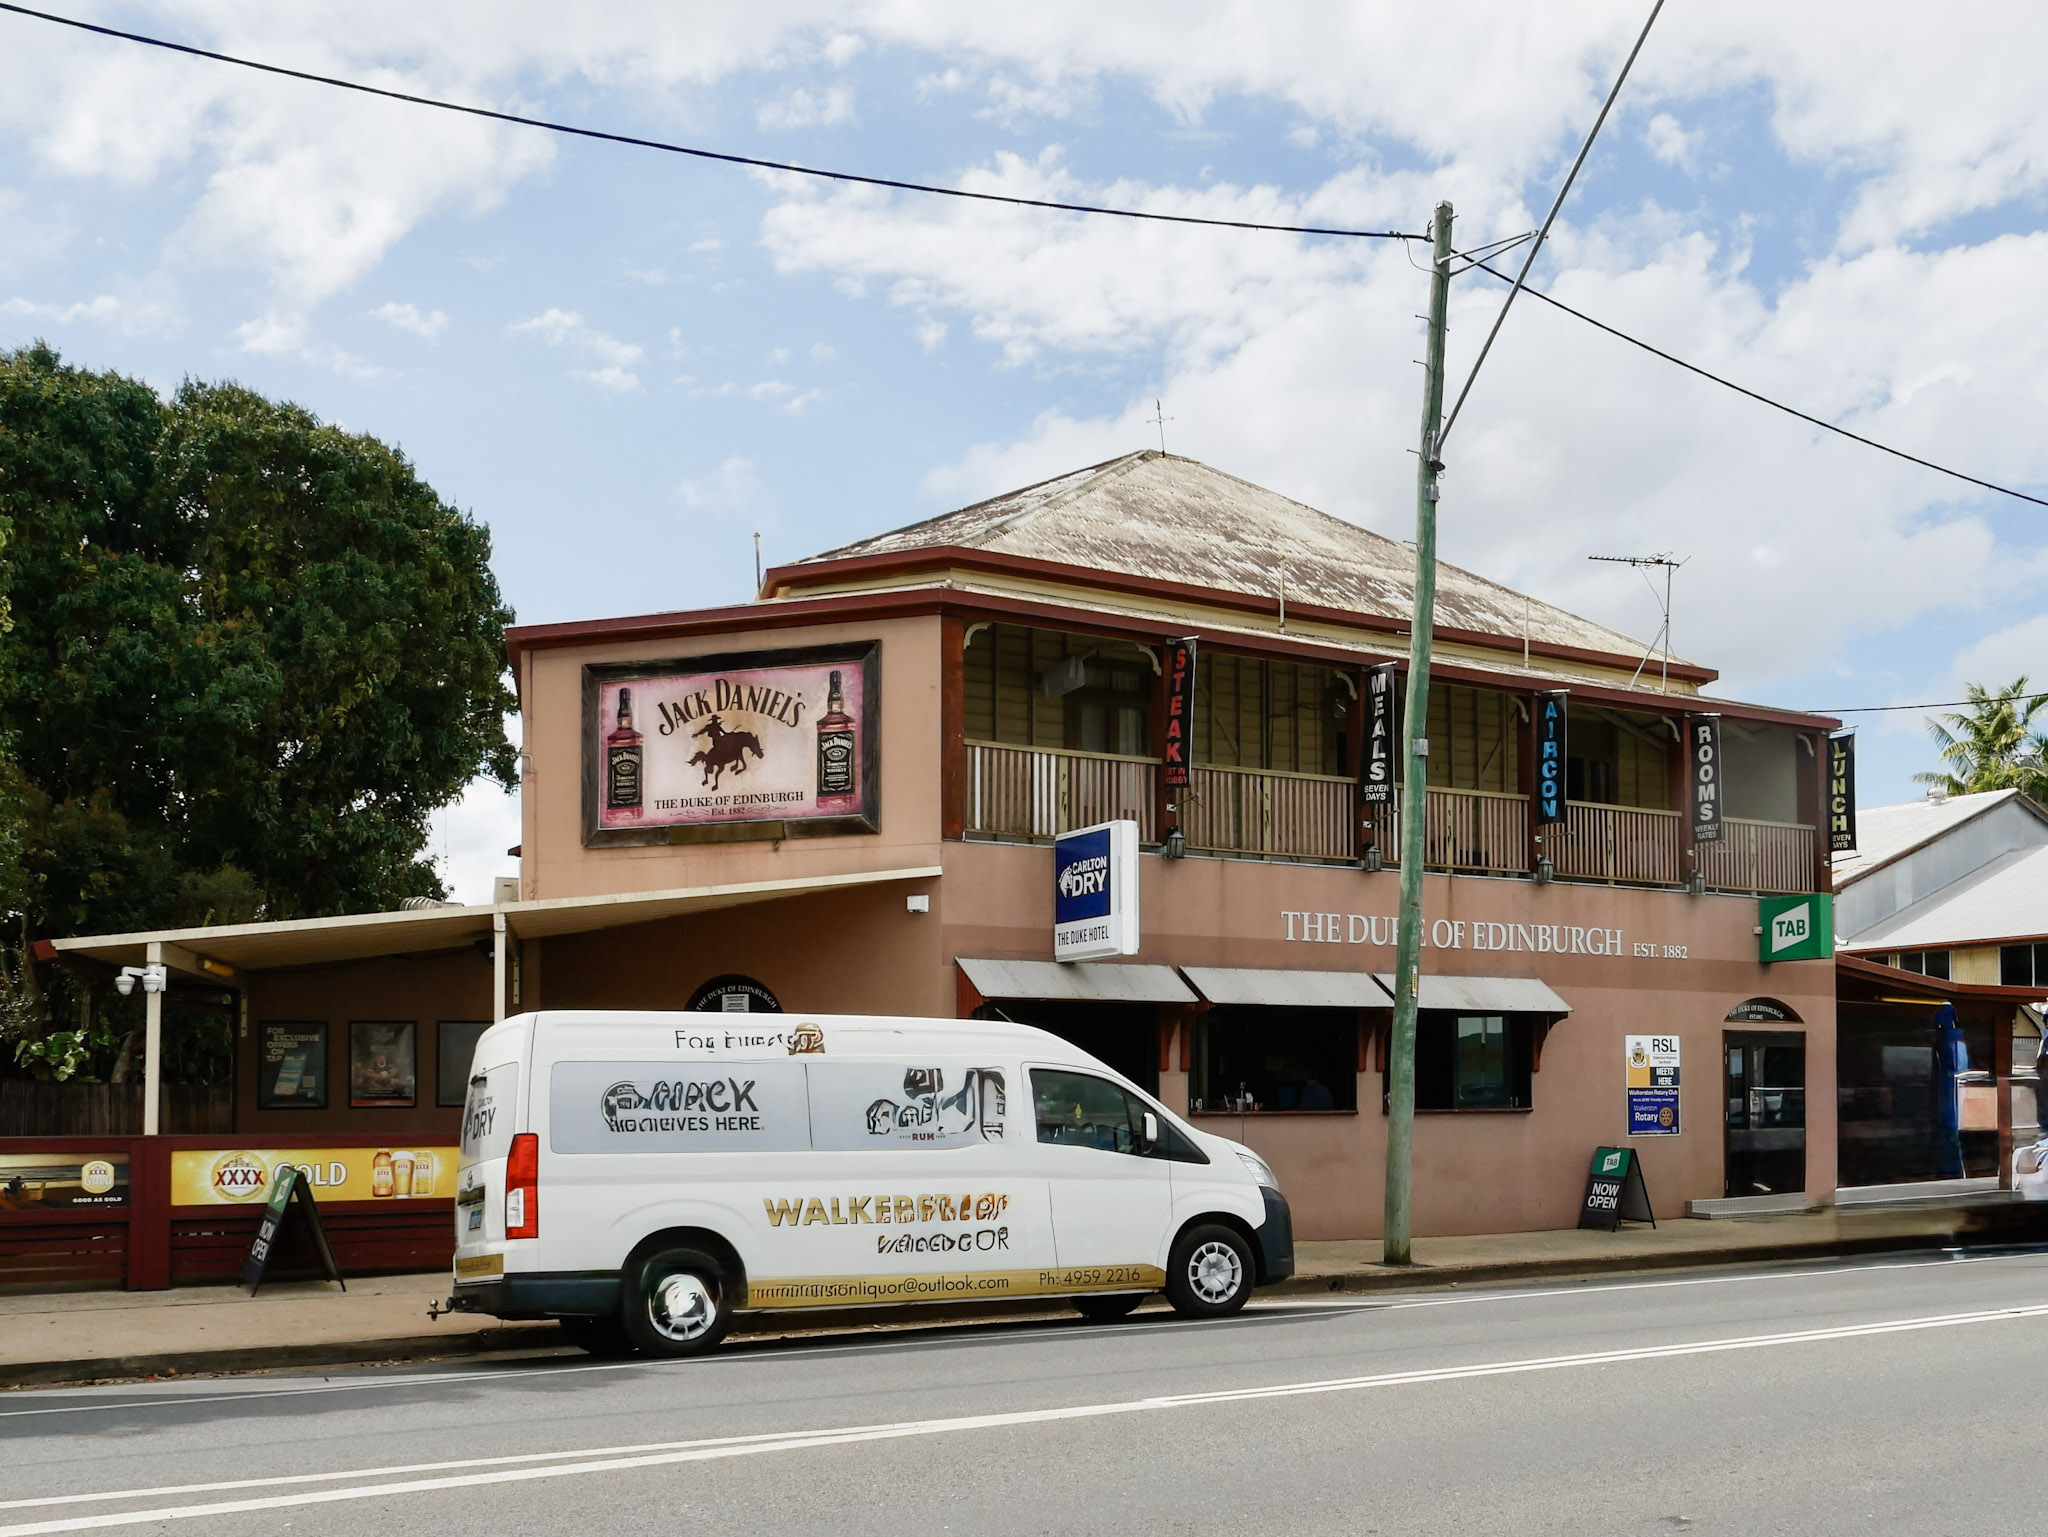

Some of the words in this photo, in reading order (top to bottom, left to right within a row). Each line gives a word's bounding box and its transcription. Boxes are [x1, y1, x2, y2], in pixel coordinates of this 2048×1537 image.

[657, 689, 712, 736] JACK
[715, 678, 806, 728] DANIEL'S
[1166, 649, 1186, 762] STEAK
[1369, 673, 1387, 781] MEALS
[1541, 701, 1558, 817] AIRCON
[1698, 725, 1715, 821] ROOMS
[1364, 784, 1389, 793] SEVEN
[1832, 741, 1847, 832] LUNCH
[655, 799, 678, 810] THE
[680, 797, 712, 808] DUKE
[715, 795, 730, 806] OF
[733, 791, 804, 805] EDINBURGH
[1366, 792, 1386, 801] DAYS
[729, 807, 745, 815] 1882
[1694, 823, 1719, 833] WEEKLY
[1832, 834, 1851, 842] EVEN
[1072, 856, 1107, 875] CARLTON
[1072, 869, 1107, 897] DRY
[1058, 932, 1069, 946] THE
[1071, 928, 1088, 944] DUKE
[1089, 925, 1109, 942] HOTEL
[1280, 910, 1342, 944] THE
[1432, 919, 1466, 949] OF
[1472, 921, 1623, 956] EDINBURGH
[1633, 943, 1659, 958] EST.
[1662, 945, 1688, 959] 1882
[1775, 919, 1806, 938] TAB
[696, 997, 708, 1011] THE
[707, 986, 727, 1000] DUKE
[738, 985, 777, 1009] EDINBURGH
[273, 1034, 320, 1042] EXCLUSIVE
[1652, 1038, 1677, 1053] RSL
[1656, 1067, 1674, 1076] MEETS
[1658, 1077, 1673, 1085] HERE
[472, 1107, 497, 1140] DRY
[1635, 1112, 1658, 1122] Rotary
[912, 1133, 935, 1141] RUM
[1606, 1158, 1618, 1166] TAB
[84, 1176, 112, 1186] GOLD
[214, 1169, 265, 1186] XXXX
[1592, 1183, 1620, 1196] NOW
[1587, 1195, 1618, 1209] OPEN
[259, 1220, 276, 1242] NOW
[251, 1237, 270, 1262] OPEN
[1040, 1272, 1060, 1286] Ph:
[1064, 1269, 1100, 1285] 4959
[1106, 1268, 1140, 1282] 2216
